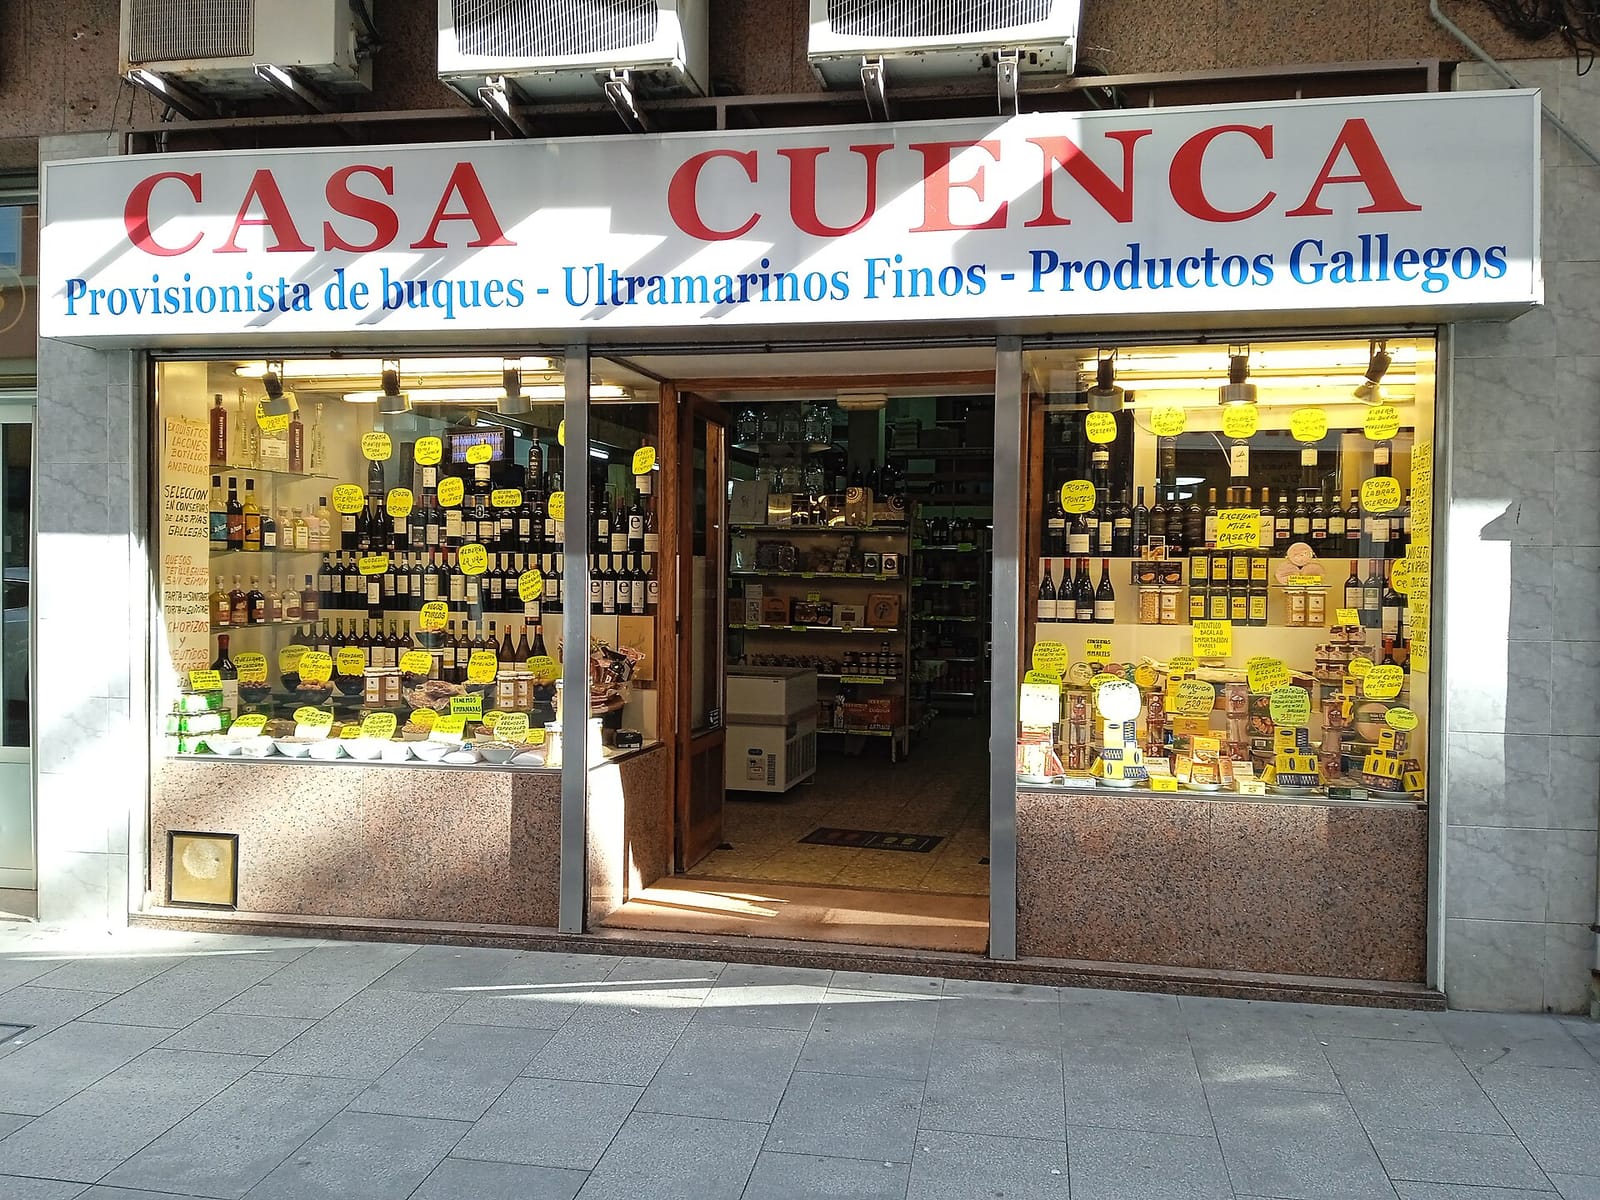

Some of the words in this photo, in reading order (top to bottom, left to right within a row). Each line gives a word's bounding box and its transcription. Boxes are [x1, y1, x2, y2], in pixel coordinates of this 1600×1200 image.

[124, 161, 518, 257] CASA
[667, 117, 1423, 242] CUENCA
[64, 271, 313, 316] Provisionista
[324, 267, 370, 311] de
[380, 267, 526, 319] buques
[562, 258, 850, 307] Ultramarinos
[864, 254, 987, 299] Finos
[1028, 243, 1275, 293] Productos
[1289, 233, 1508, 294] Gallegos
[1365, 480, 1391, 490] RIOJA
[1226, 522, 1252, 530] MIEL
[1219, 532, 1257, 544] CASERO
